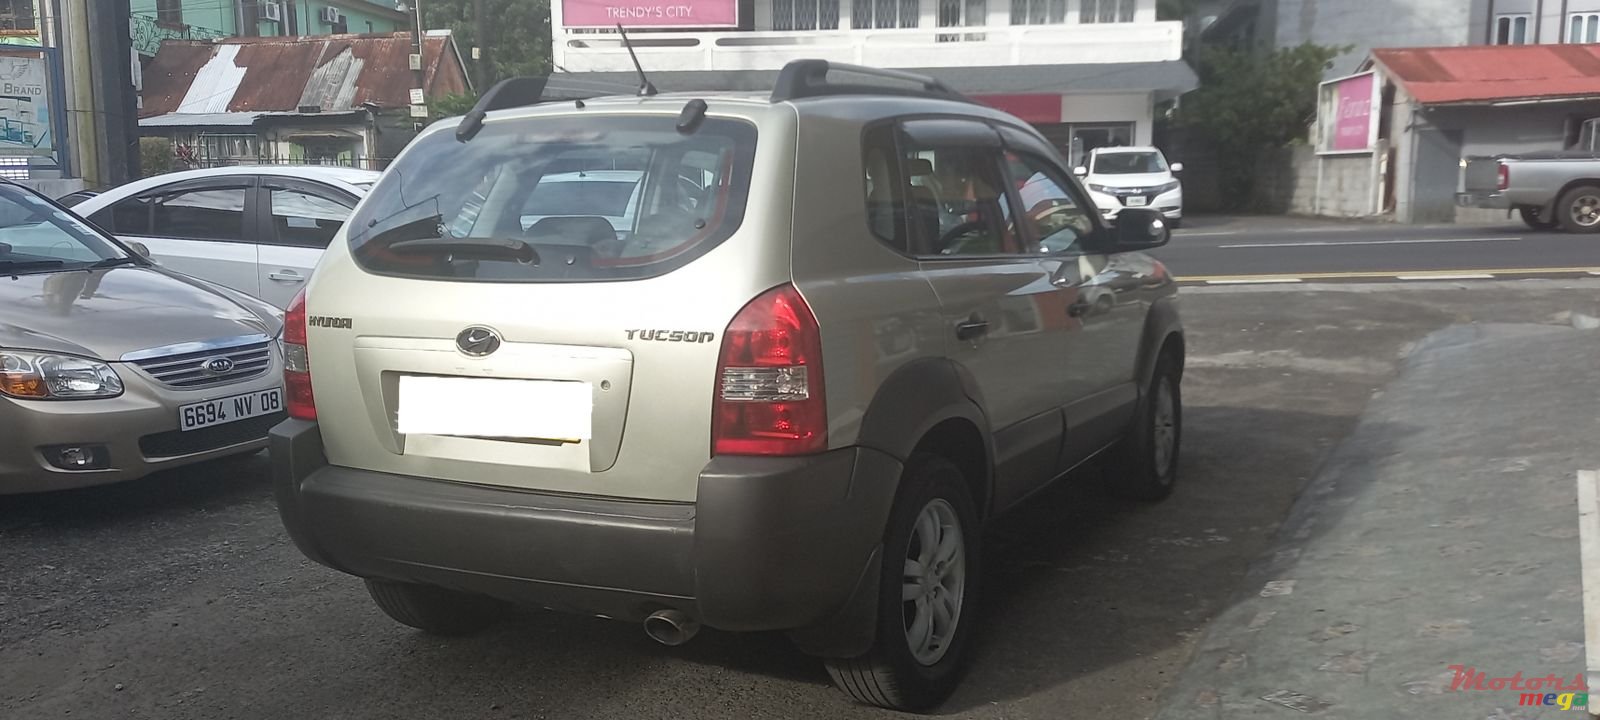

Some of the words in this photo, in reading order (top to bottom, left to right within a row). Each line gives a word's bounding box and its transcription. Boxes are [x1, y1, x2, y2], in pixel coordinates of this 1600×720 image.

[606, 7, 662, 18] TRENDY'S
[666, 6, 693, 17] CITY
[308, 315, 353, 329] HYUNDAI
[624, 329, 715, 343] TUCSON
[209, 359, 232, 371] KIA
[183, 400, 226, 428] 6694
[233, 396, 252, 418] NV
[260, 391, 279, 412] 08
